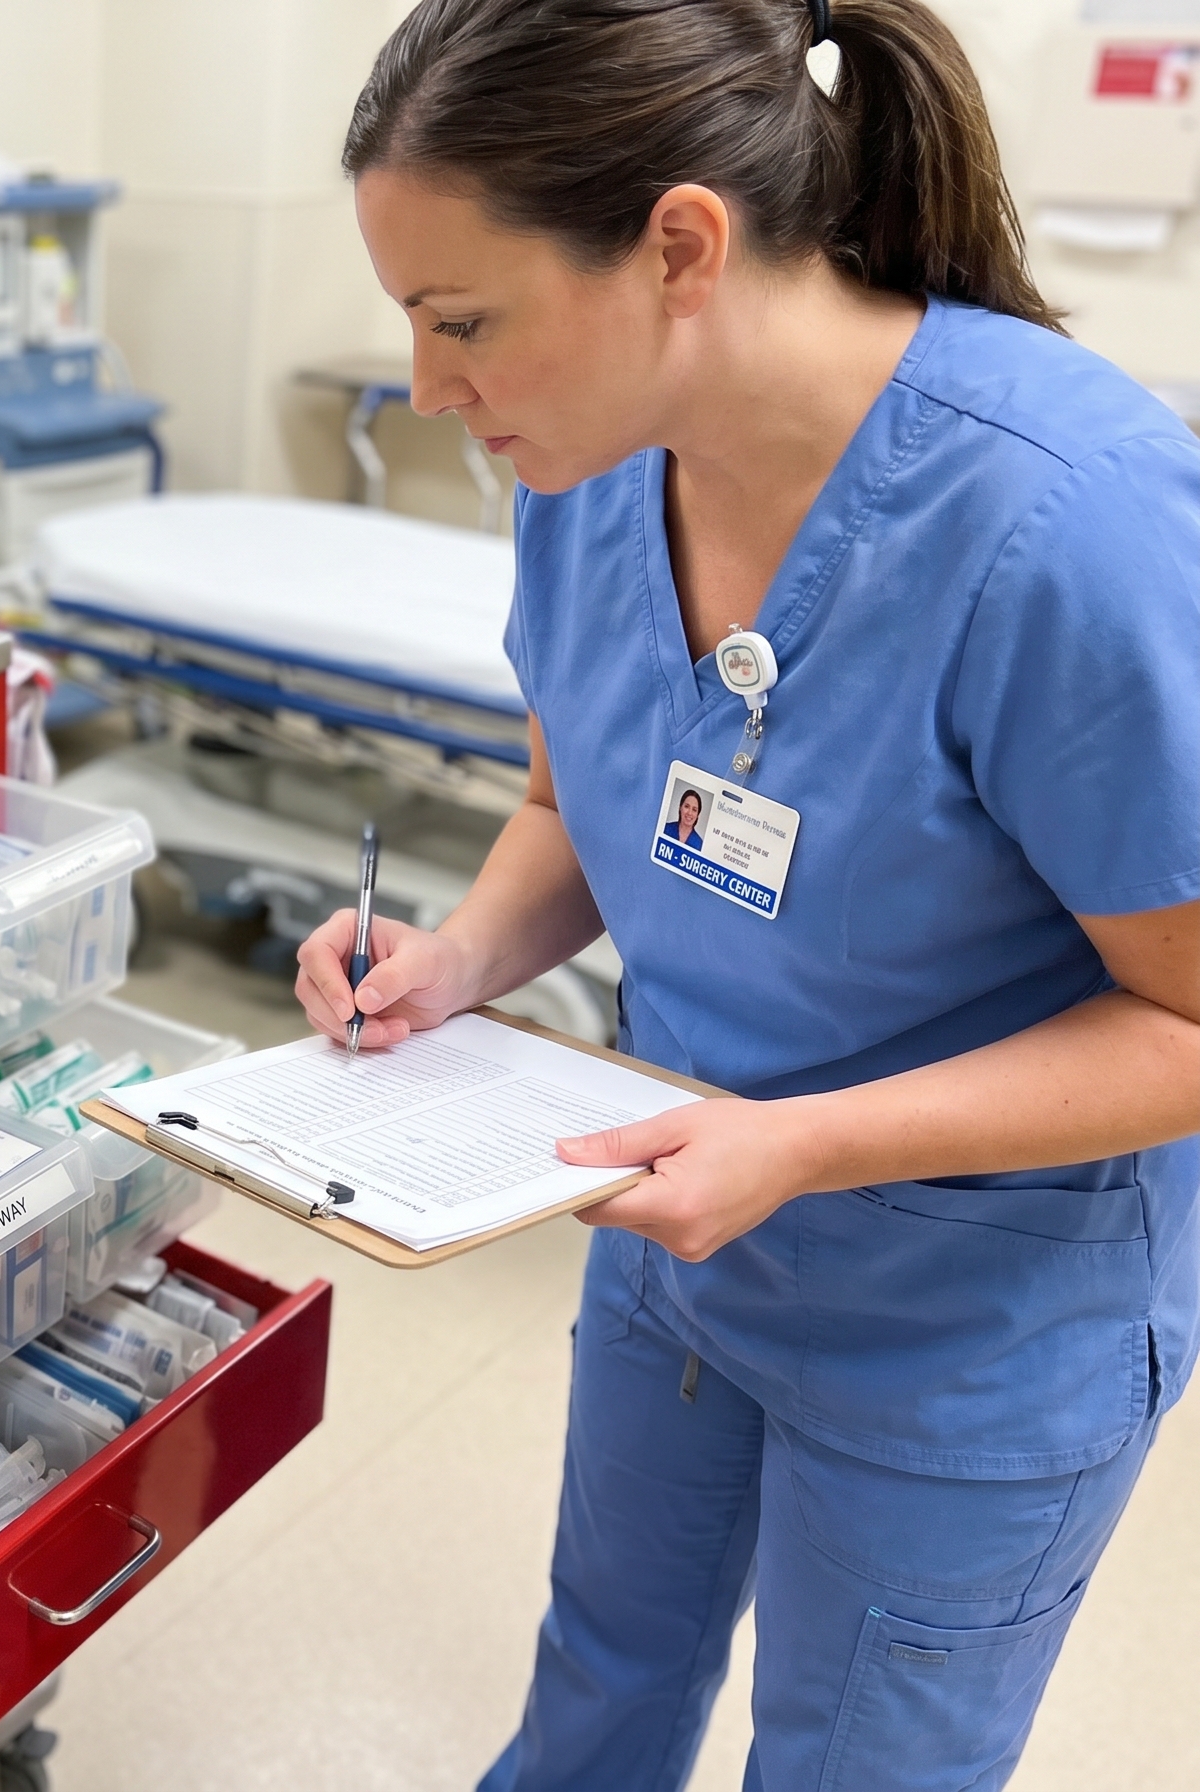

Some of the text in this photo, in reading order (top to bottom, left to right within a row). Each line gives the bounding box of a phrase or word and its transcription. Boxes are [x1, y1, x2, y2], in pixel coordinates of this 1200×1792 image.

[657, 843, 674, 861] RN
[679, 853, 729, 887] SURGERY
[728, 877, 772, 909] CENTER
